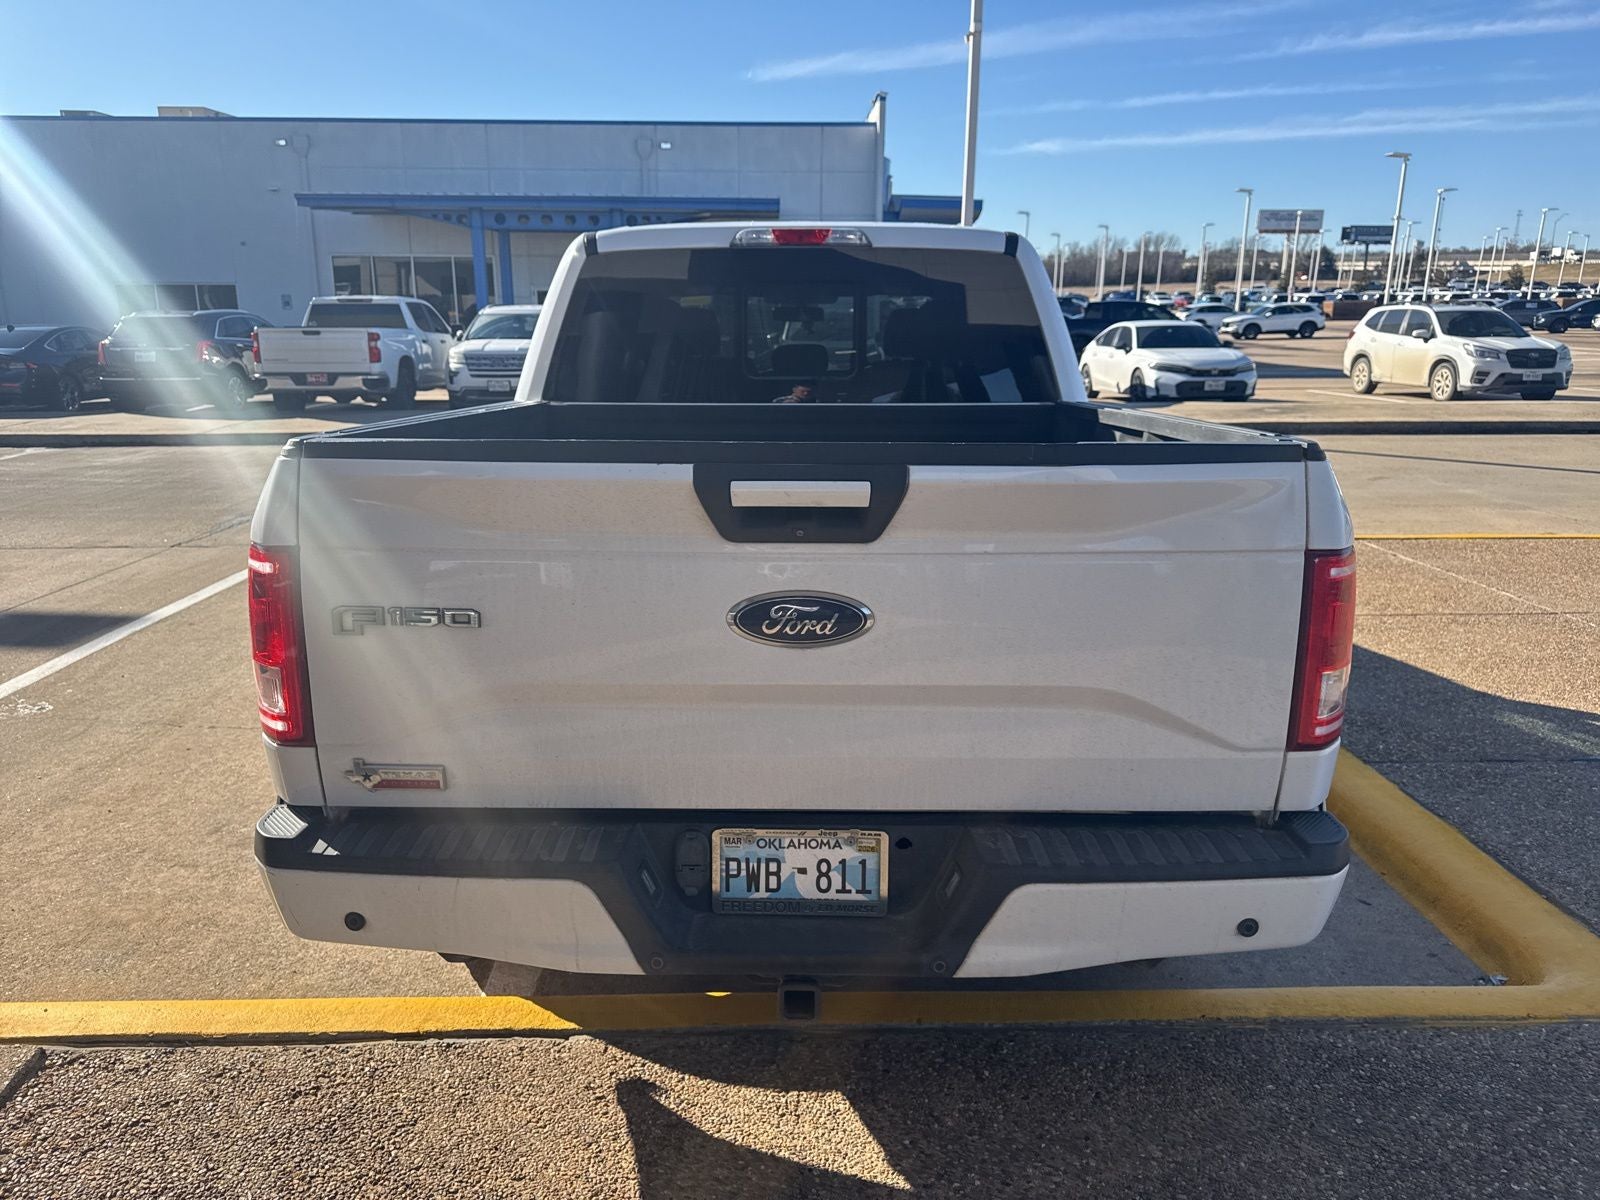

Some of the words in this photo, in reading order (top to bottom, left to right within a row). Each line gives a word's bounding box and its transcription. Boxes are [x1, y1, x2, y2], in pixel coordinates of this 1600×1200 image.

[761, 604, 839, 635] Ford
[380, 771, 437, 779] TEXAS
[818, 829, 838, 837] Jeep
[724, 837, 742, 845] MAR
[756, 838, 843, 851] OKLAHOMA
[724, 857, 782, 893] PWB
[815, 858, 872, 894] 811
[721, 901, 800, 912] FREEDOM
